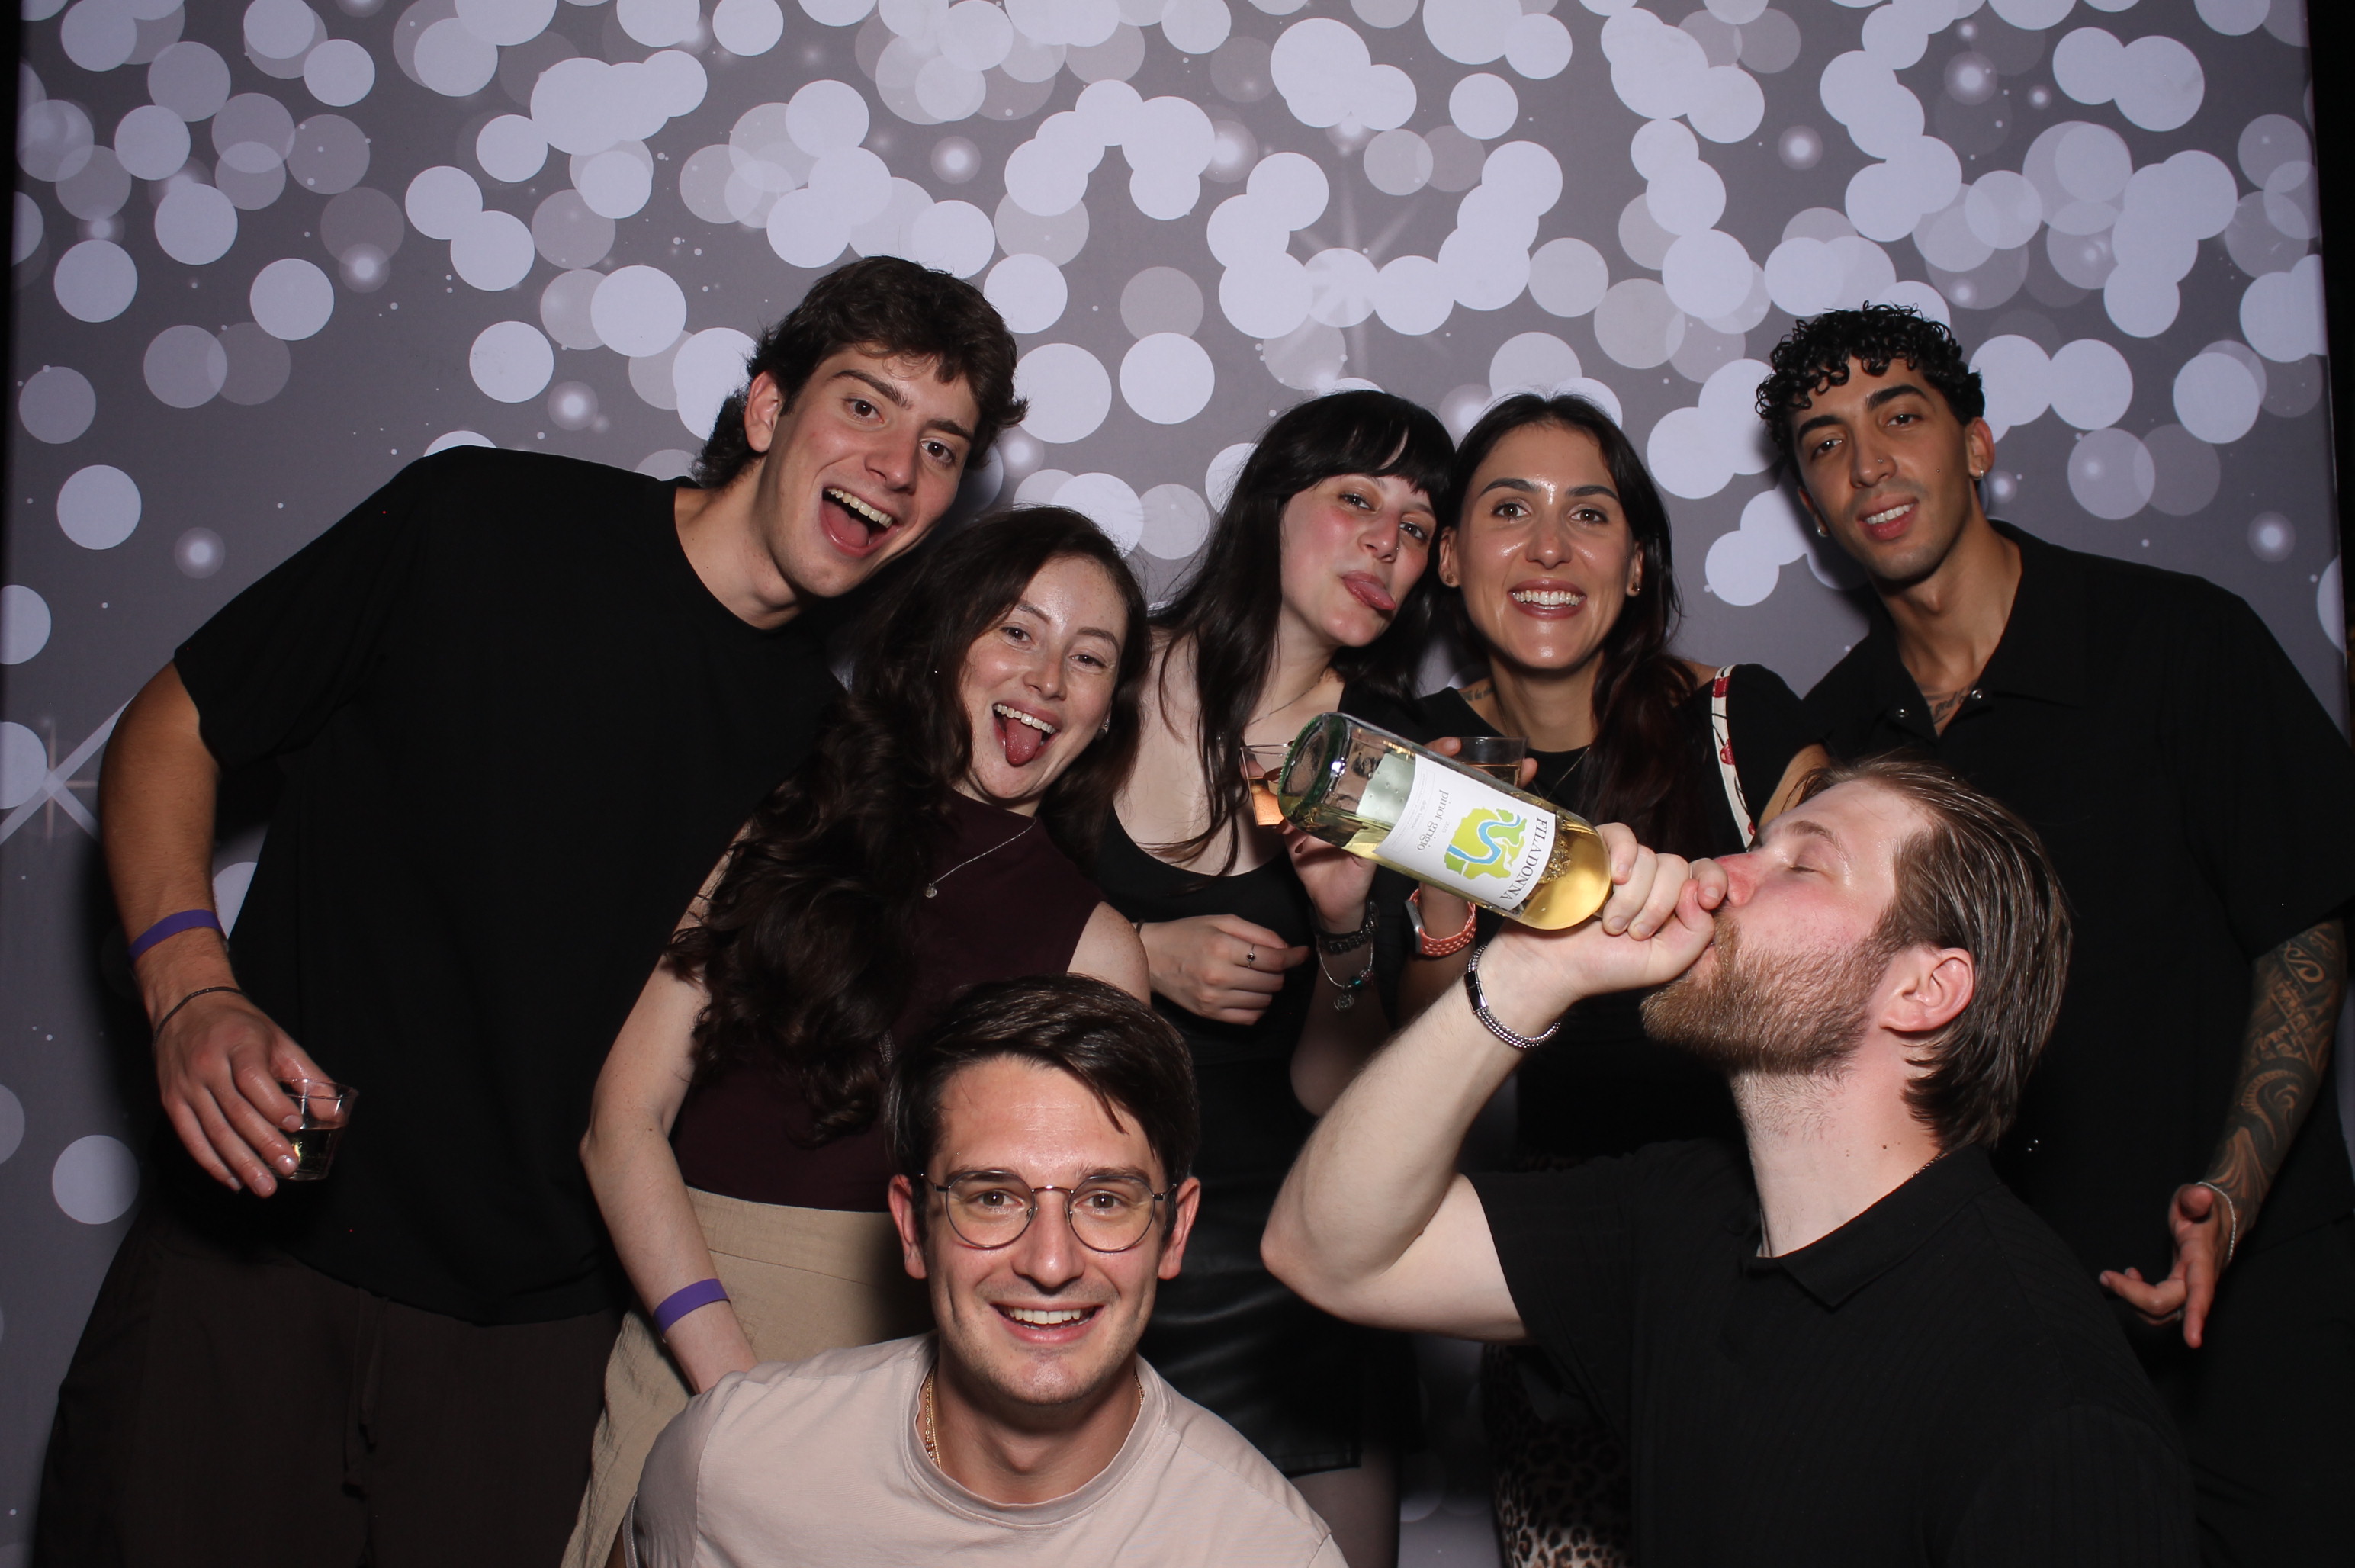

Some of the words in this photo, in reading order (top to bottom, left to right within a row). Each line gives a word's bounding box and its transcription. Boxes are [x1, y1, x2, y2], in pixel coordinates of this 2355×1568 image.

[1436, 789, 1451, 819] pinot
[1417, 821, 1438, 851] grigio
[1499, 817, 1547, 901] FILADONNA
